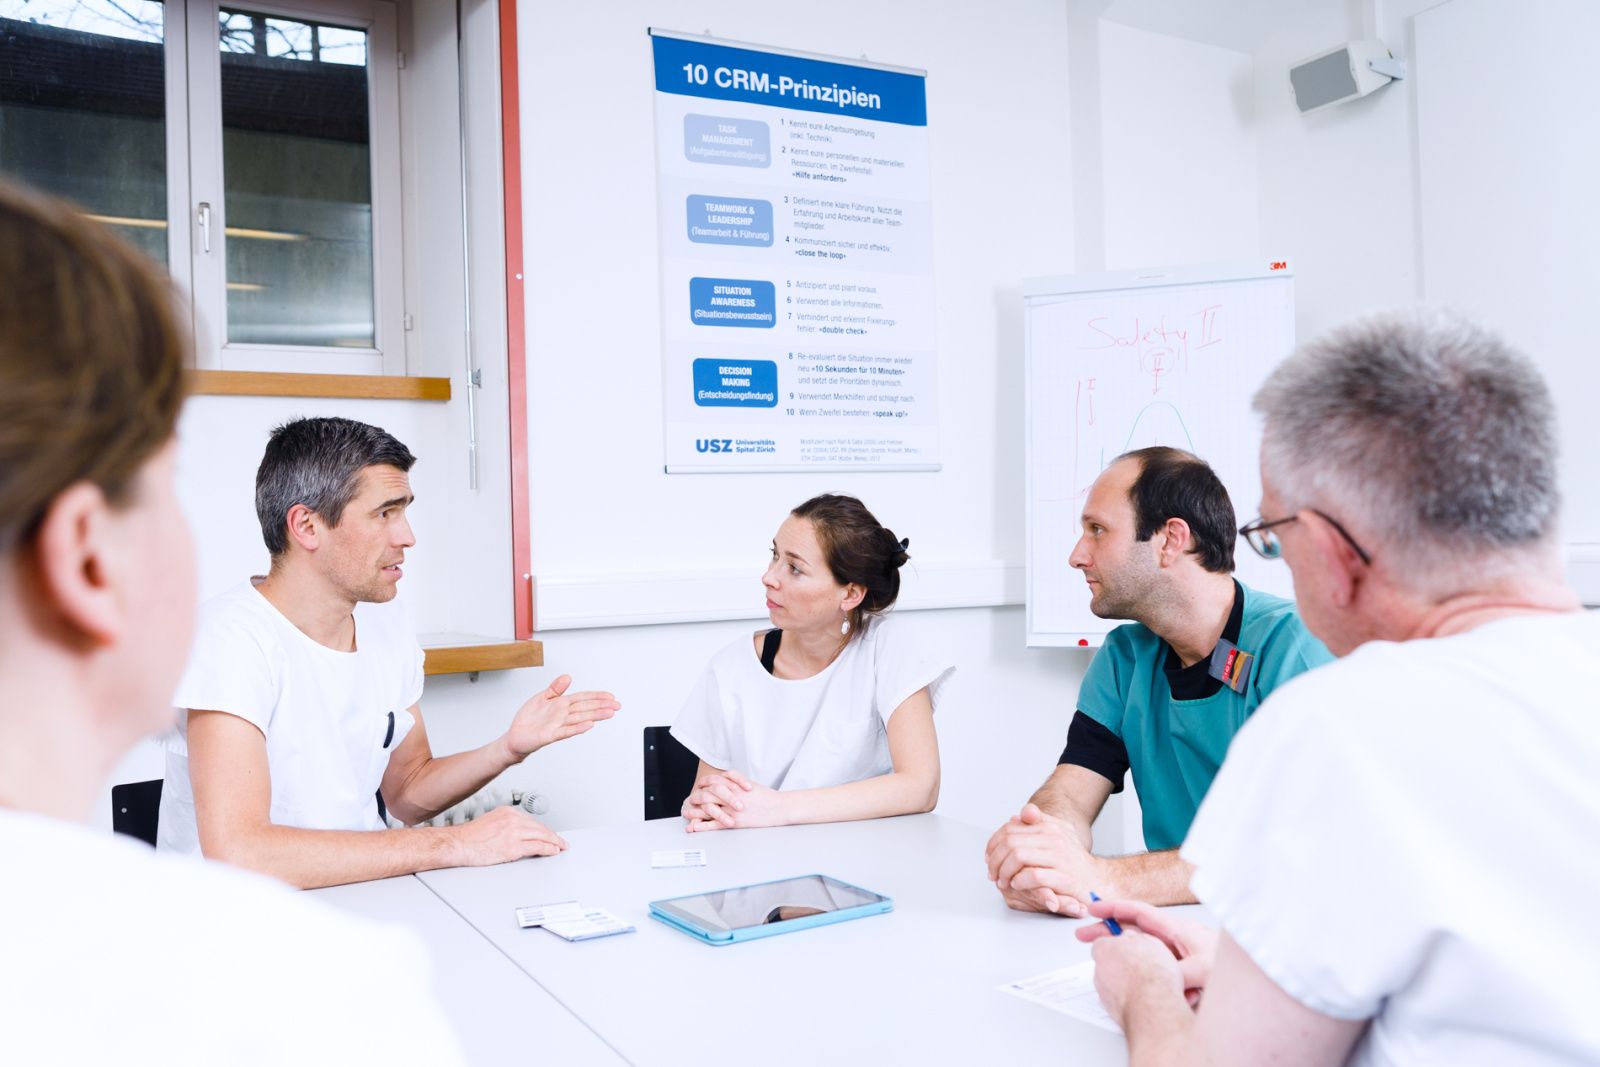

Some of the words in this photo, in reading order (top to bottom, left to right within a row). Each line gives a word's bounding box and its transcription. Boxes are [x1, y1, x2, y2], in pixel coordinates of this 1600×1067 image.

[683, 63, 708, 85] 10
[714, 66, 881, 110] CRM-Prinzipien
[718, 124, 737, 134] TASK
[789, 120, 808, 129] Kennt
[702, 134, 753, 147] MANAGEMENT
[790, 147, 809, 156] Kennt
[861, 156, 872, 164] und
[793, 196, 819, 206] Definiert
[705, 203, 748, 214] TEAMWORK
[749, 207, 755, 215] &
[793, 208, 824, 220] Erfahrung
[825, 212, 836, 220] und
[708, 215, 753, 226] LEADERSHIP
[692, 226, 732, 238] (Teamarbeit
[733, 229, 739, 238] &
[740, 229, 770, 241] Führung)
[794, 237, 837, 247] Kommuniziert
[817, 250, 828, 258] the
[1269, 261, 1287, 271] 3M
[786, 280, 791, 288] 5
[795, 280, 827, 291] Antizipiert
[713, 286, 752, 296] SITUATION
[710, 297, 756, 308] AWARENESS
[786, 296, 792, 304] 6
[795, 297, 829, 306] Verwendet
[694, 309, 773, 322] (Situationsbewusstsein)
[788, 312, 792, 320] 7
[797, 312, 829, 322] Verhindert
[843, 316, 866, 324] erkennt
[788, 352, 793, 360] 8
[837, 354, 847, 362] die
[848, 354, 873, 363] Situation
[719, 366, 753, 376] DECISION
[825, 365, 858, 374] Sekunden
[859, 366, 868, 374] für
[722, 378, 751, 387] MAKING
[798, 377, 810, 385] und
[812, 377, 827, 385] setzt
[828, 377, 838, 385] die
[698, 390, 774, 402] (Entscheidungsfindung)
[790, 392, 795, 400] 9
[798, 392, 832, 401] Verwendet
[833, 392, 866, 401] Merkhilfen
[867, 394, 878, 402] und
[786, 408, 795, 416] 10
[799, 408, 818, 416] Wenn
[818, 408, 841, 417] Zweifel
[696, 439, 733, 453] USZ
